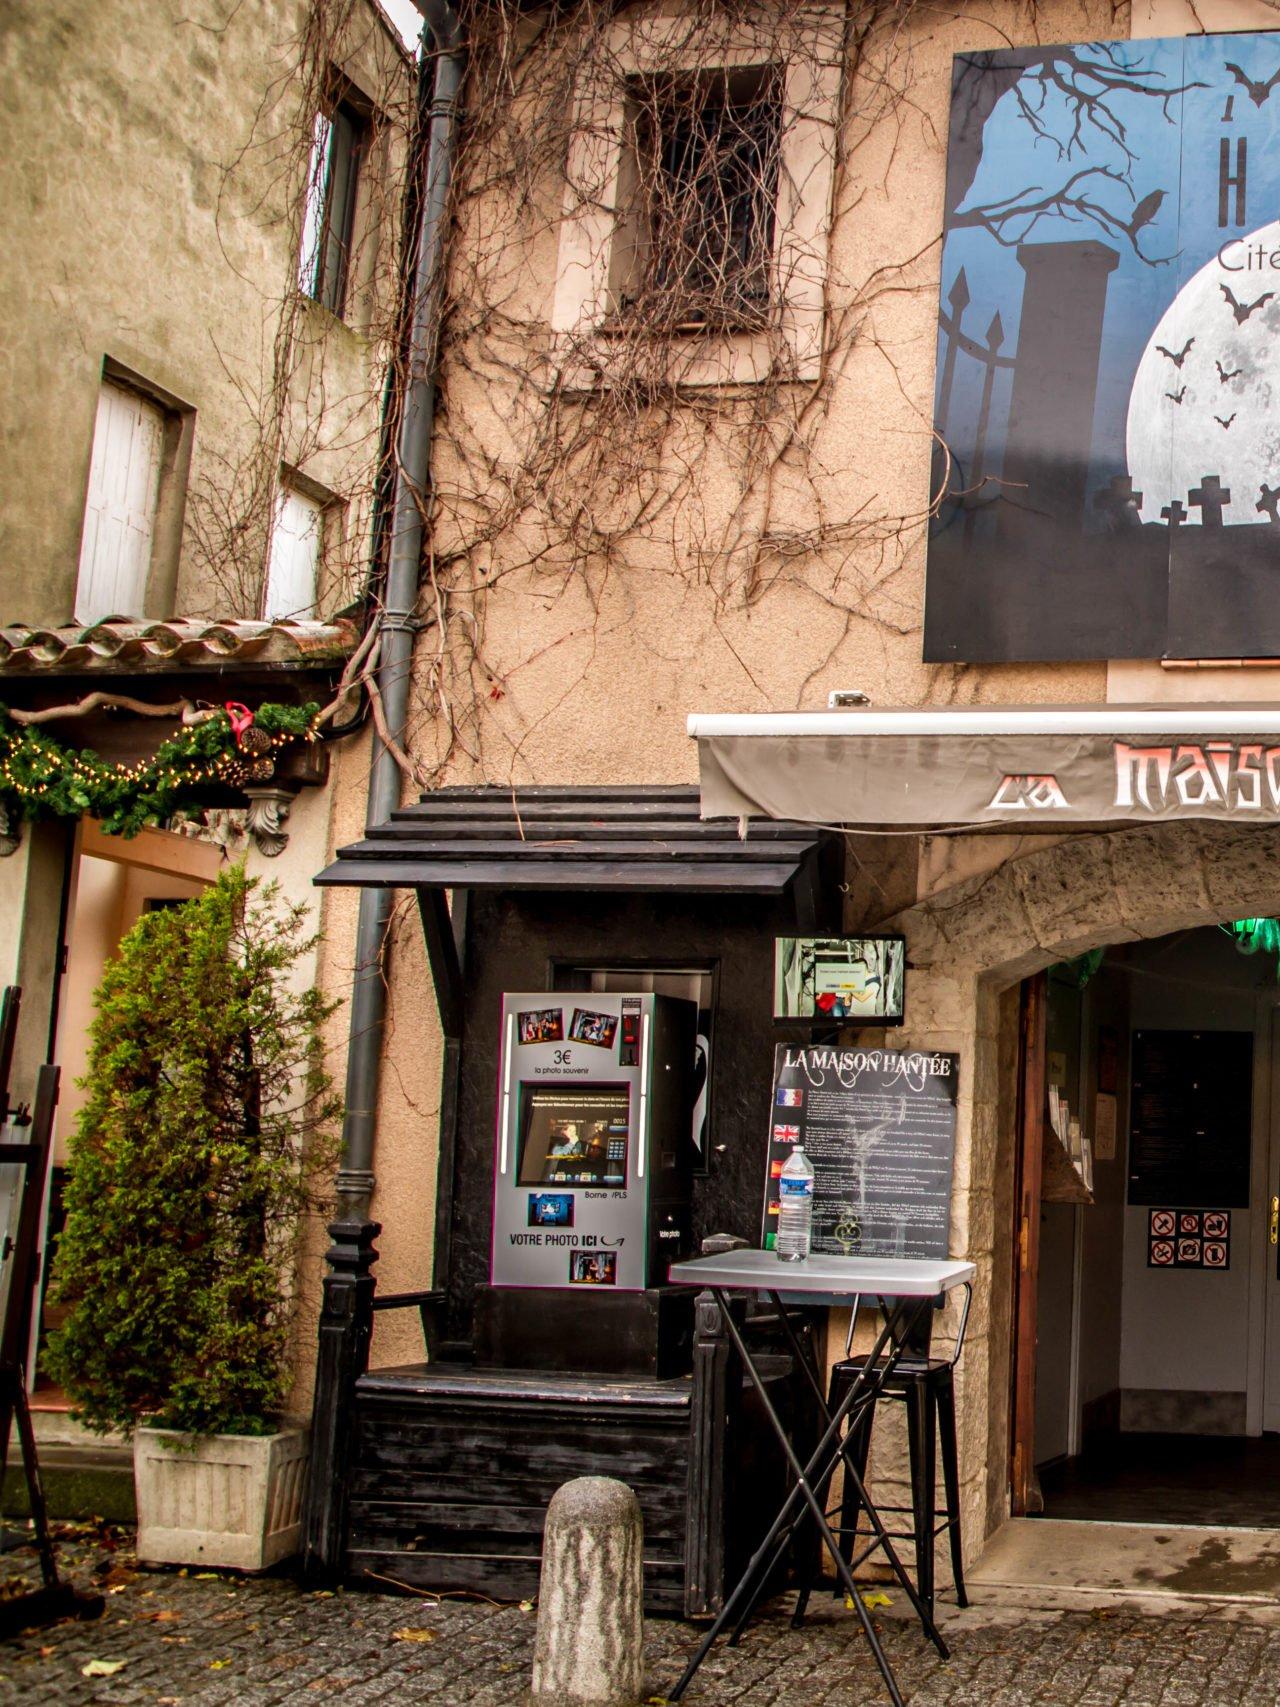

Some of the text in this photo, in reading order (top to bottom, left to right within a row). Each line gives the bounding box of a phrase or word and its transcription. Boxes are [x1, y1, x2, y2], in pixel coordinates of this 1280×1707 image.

[553, 1049, 572, 1065] 3€
[534, 1066, 589, 1075] la photo souvenir
[812, 1050, 883, 1089] MAISON
[882, 1052, 952, 1092] HANTÉE
[584, 1191, 608, 1199] Borne
[509, 1233, 598, 1247] VOTRE PHOTO ICI
